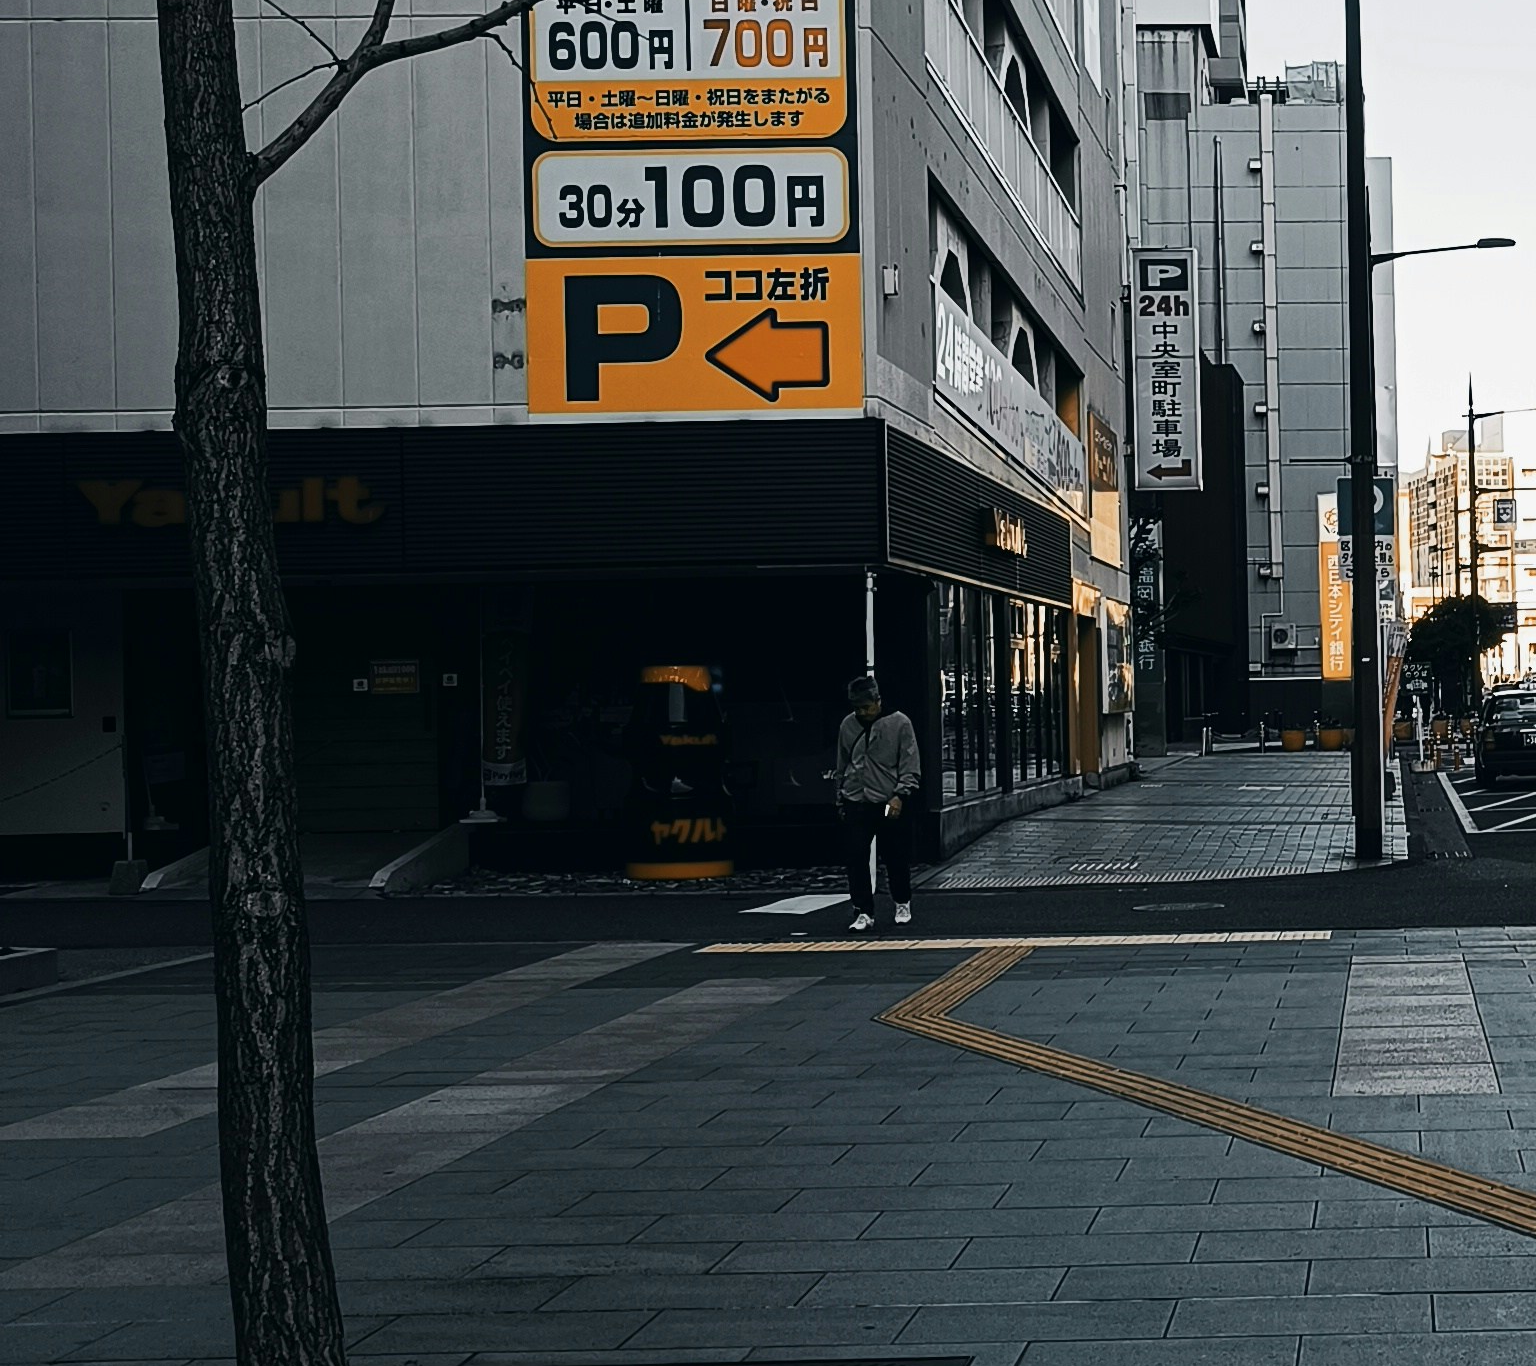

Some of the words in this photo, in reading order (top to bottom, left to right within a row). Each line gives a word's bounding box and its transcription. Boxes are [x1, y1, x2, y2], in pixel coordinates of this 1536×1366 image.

[548, 19, 674, 70] 600円
[703, 18, 829, 69] 700円
[574, 110, 804, 130] 場合は追加料金が発生します
[704, 267, 829, 301] ココ左折
[1147, 266, 1182, 287] P
[1139, 295, 1189, 317] 24h
[564, 273, 683, 403] P
[1151, 321, 1182, 458] 中央室町駐車場
[76, 475, 388, 527] Yault
[994, 507, 1028, 559] Yakult
[1346, 567, 1390, 579] こら
[1137, 567, 1155, 671] 福岡銀行
[1327, 555, 1346, 671] 西日本シティ銀行
[1403, 664, 1430, 672] タクシー
[650, 817, 728, 845] ヤクルト
